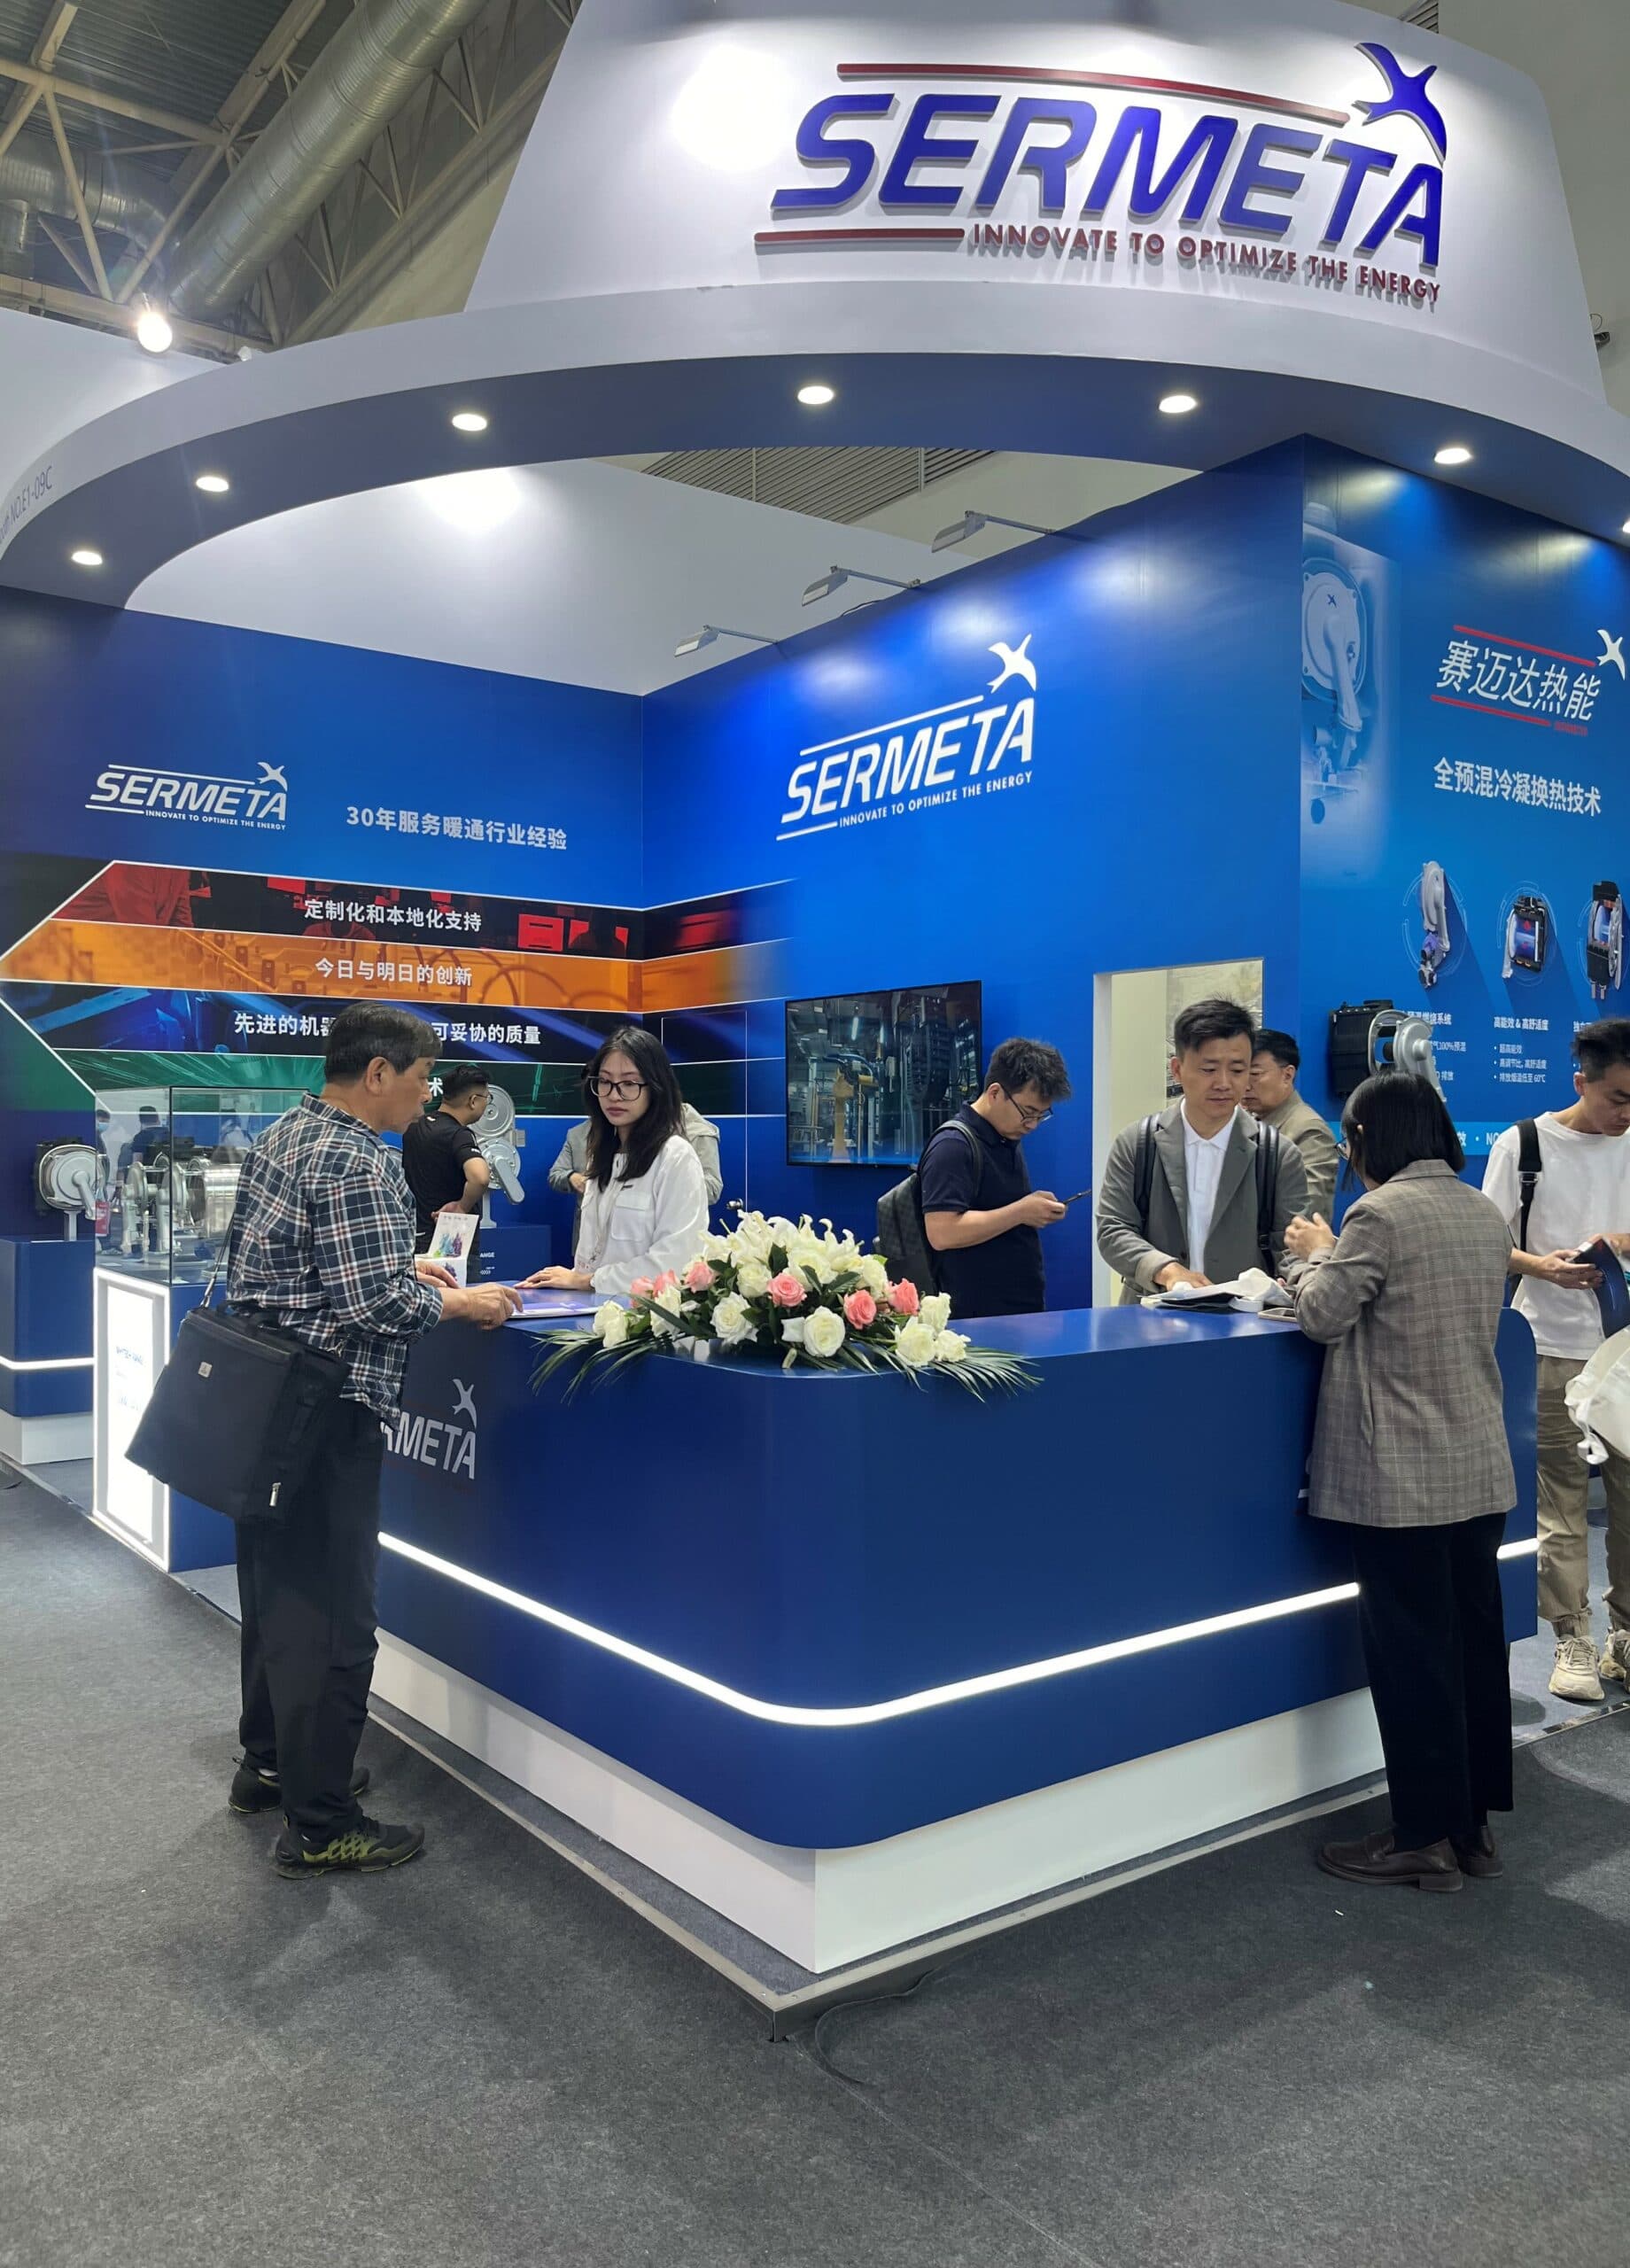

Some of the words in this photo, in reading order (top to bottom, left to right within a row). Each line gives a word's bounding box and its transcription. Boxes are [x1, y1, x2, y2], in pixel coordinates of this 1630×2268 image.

[771, 93, 1445, 270] SERMETA
[974, 223, 1117, 251] INNOVATE
[1131, 232, 1165, 256] TO
[1178, 237, 1297, 272] OPTIMIZE
[1308, 255, 1347, 283] THE
[1359, 265, 1440, 302] ENERGY
[1435, 640, 1602, 721] 赛迈达热能
[780, 697, 1035, 824] SERMETA
[1433, 757, 1602, 817] 全预混冷凝换热技术
[89, 772, 287, 821] SERMETA
[145, 810, 186, 821] INNOVATE
[202, 816, 238, 827] OPTIMIZE
[257, 822, 286, 831] ENERGY
[839, 806, 888, 827] INNOVATE
[892, 802, 904, 814] TO
[908, 789, 958, 812] OPTIMIZE
[961, 783, 982, 798] THE
[986, 771, 1033, 792] ENERGY
[346, 806, 567, 850] 30年服务暖通行业经验
[304, 898, 482, 933] 定制化和本地化支持
[315, 958, 473, 986] 今日与明日的创新
[380, 1411, 476, 1480] META
